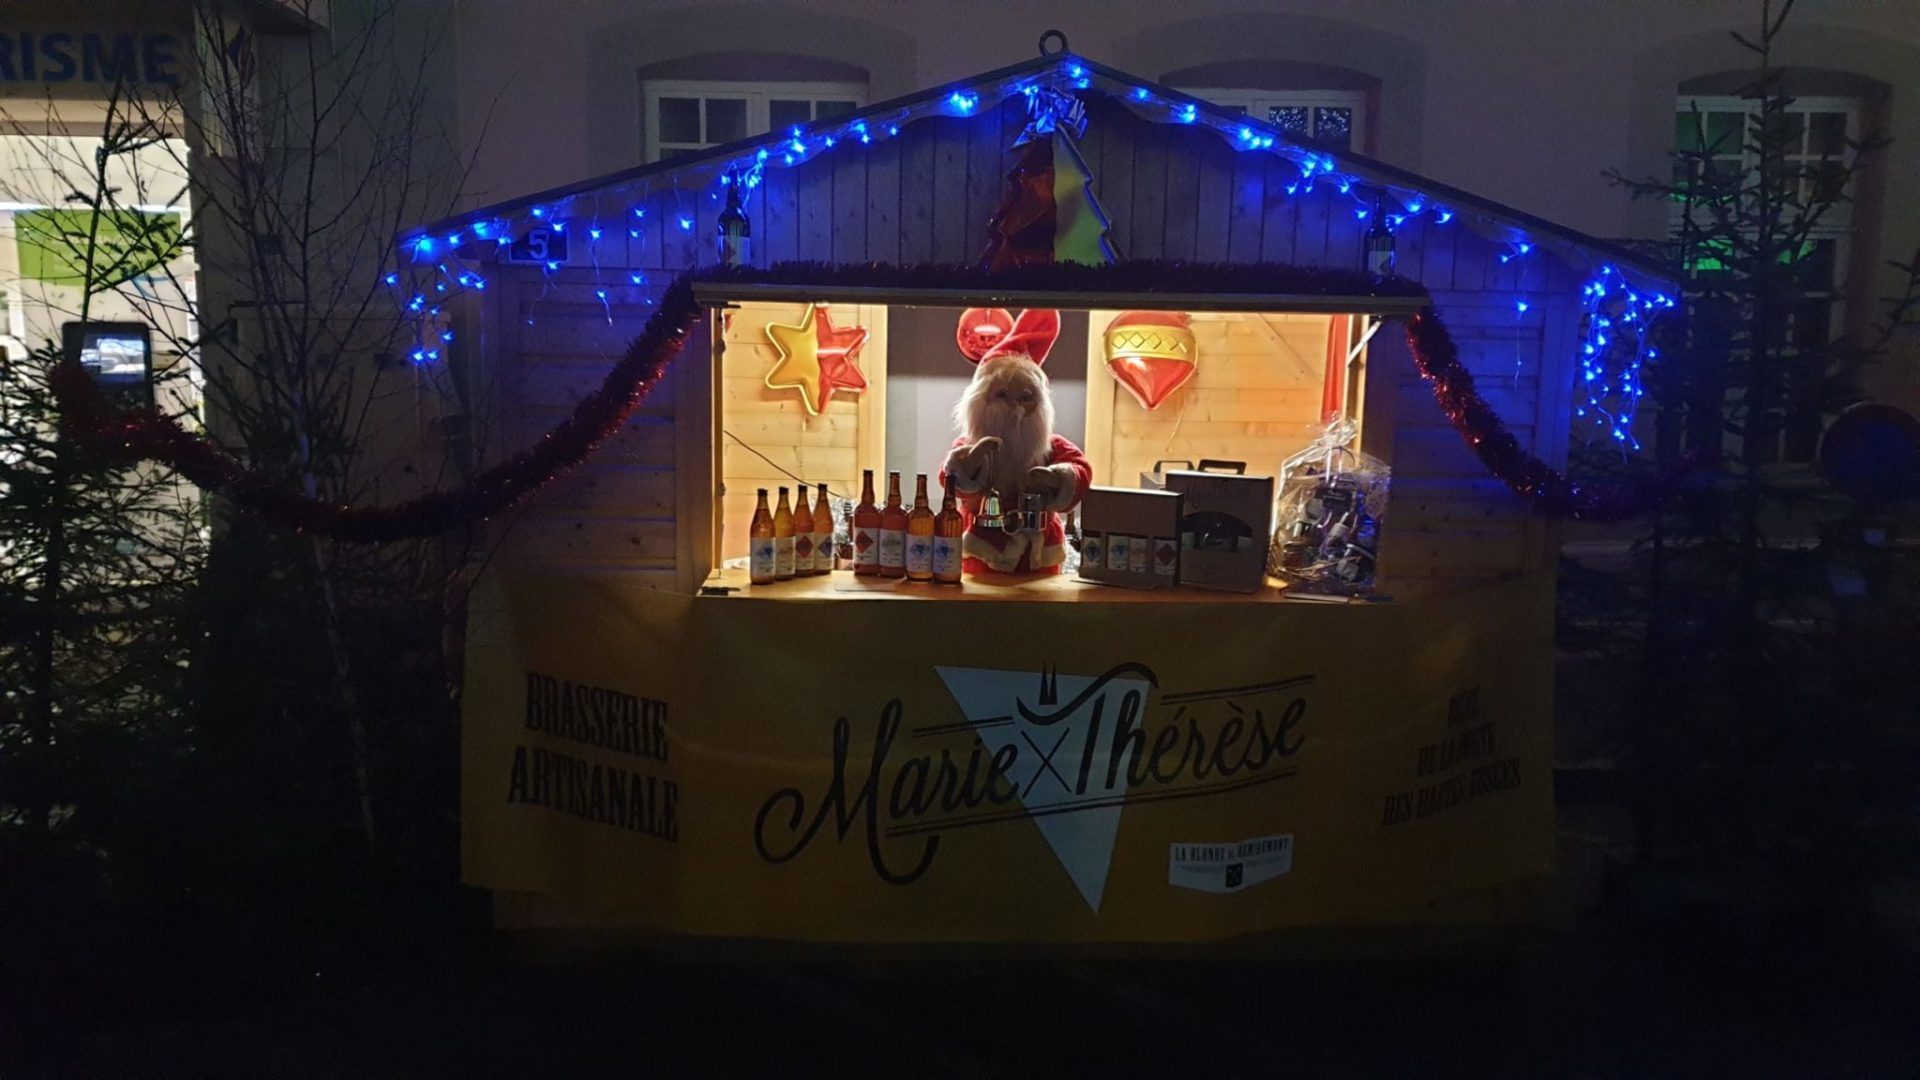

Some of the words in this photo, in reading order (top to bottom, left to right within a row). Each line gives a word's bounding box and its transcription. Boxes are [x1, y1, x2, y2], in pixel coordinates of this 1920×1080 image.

[528, 229, 550, 260] 5
[525, 671, 668, 762] BRASSERIE
[507, 745, 679, 842] ARTISANALE
[754, 696, 1020, 886] Marie
[1016, 661, 1307, 796] Thérèse
